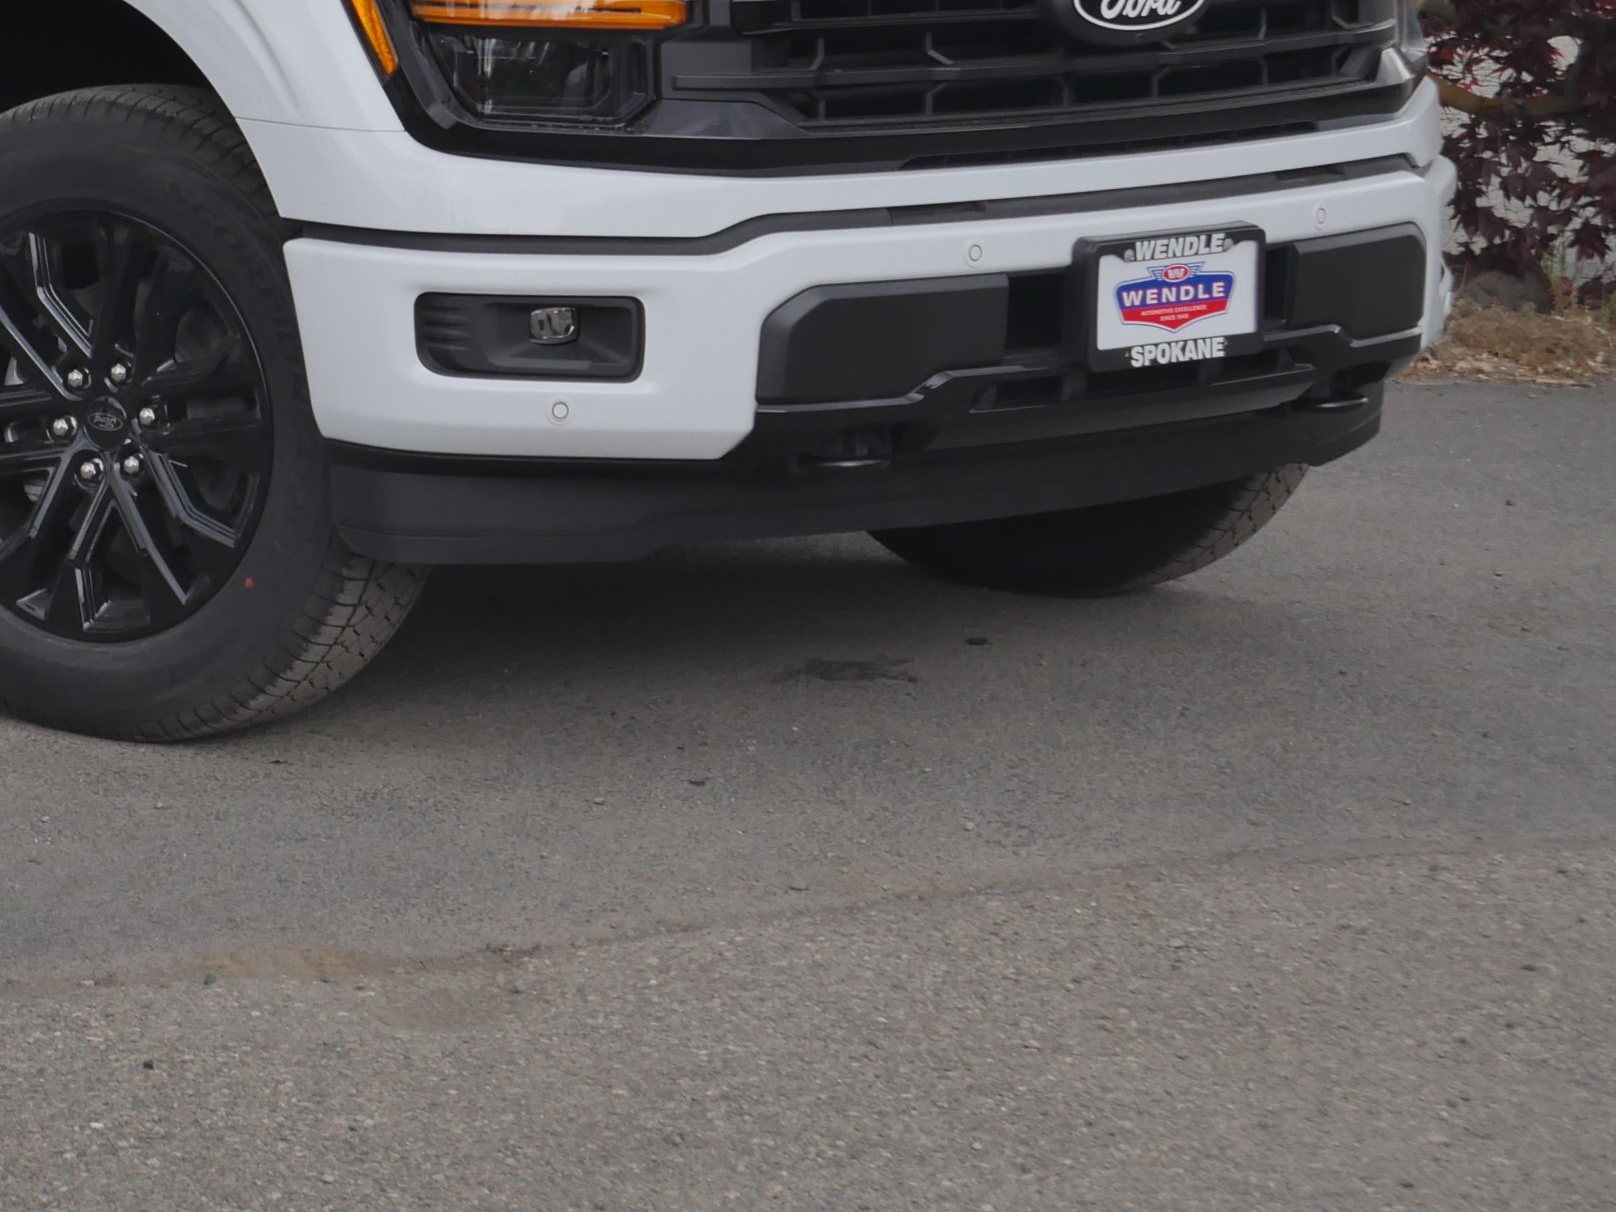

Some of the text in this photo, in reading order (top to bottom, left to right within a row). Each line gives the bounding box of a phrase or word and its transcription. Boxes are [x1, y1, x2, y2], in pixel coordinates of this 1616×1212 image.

[1134, 233, 1226, 262] WENDLE
[1122, 282, 1226, 307] WENDLE
[1130, 337, 1226, 367] SPOKANE
